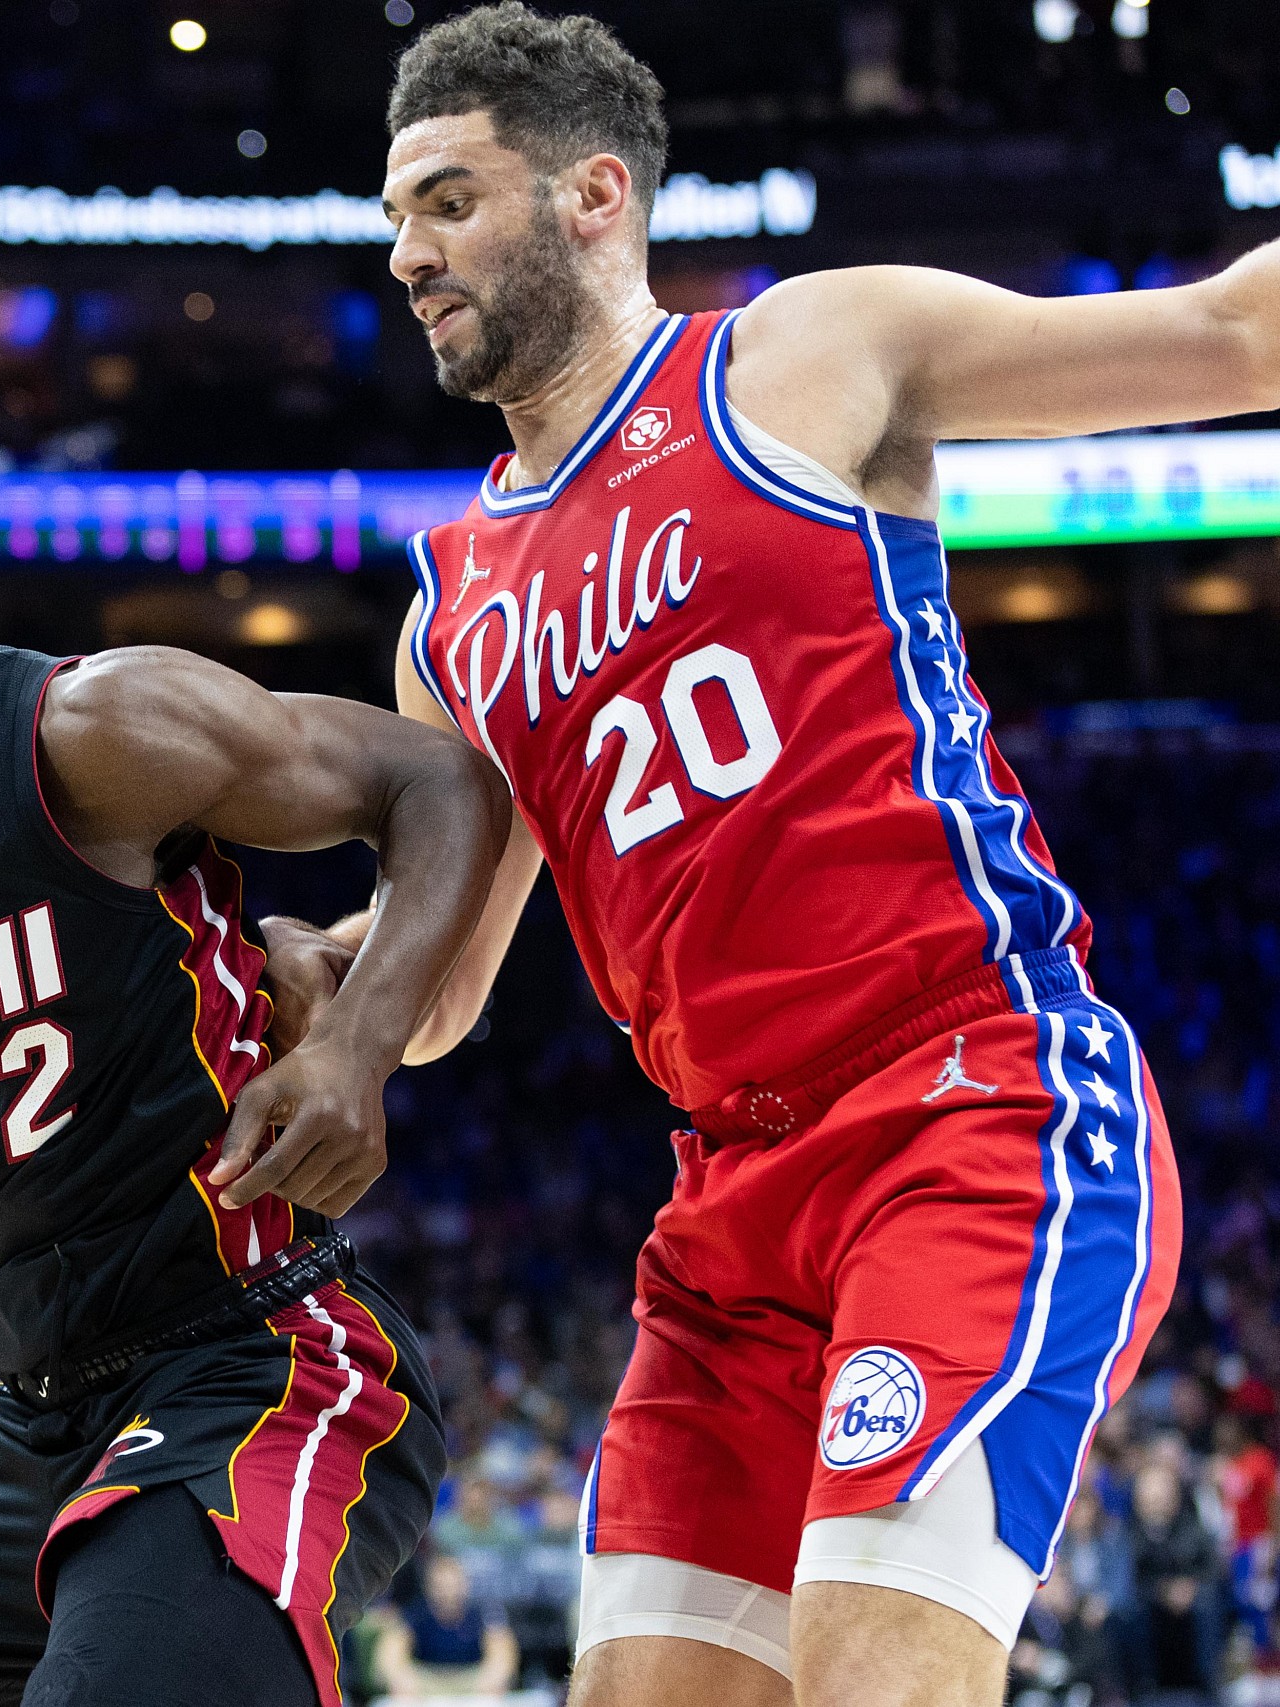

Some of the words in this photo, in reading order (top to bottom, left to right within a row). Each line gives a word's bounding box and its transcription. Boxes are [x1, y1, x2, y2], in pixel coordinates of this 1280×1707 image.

[607, 434, 696, 488] crypto.com
[446, 505, 702, 800] Phila
[583, 642, 783, 857] 20
[825, 1394, 906, 1443] 76ers
